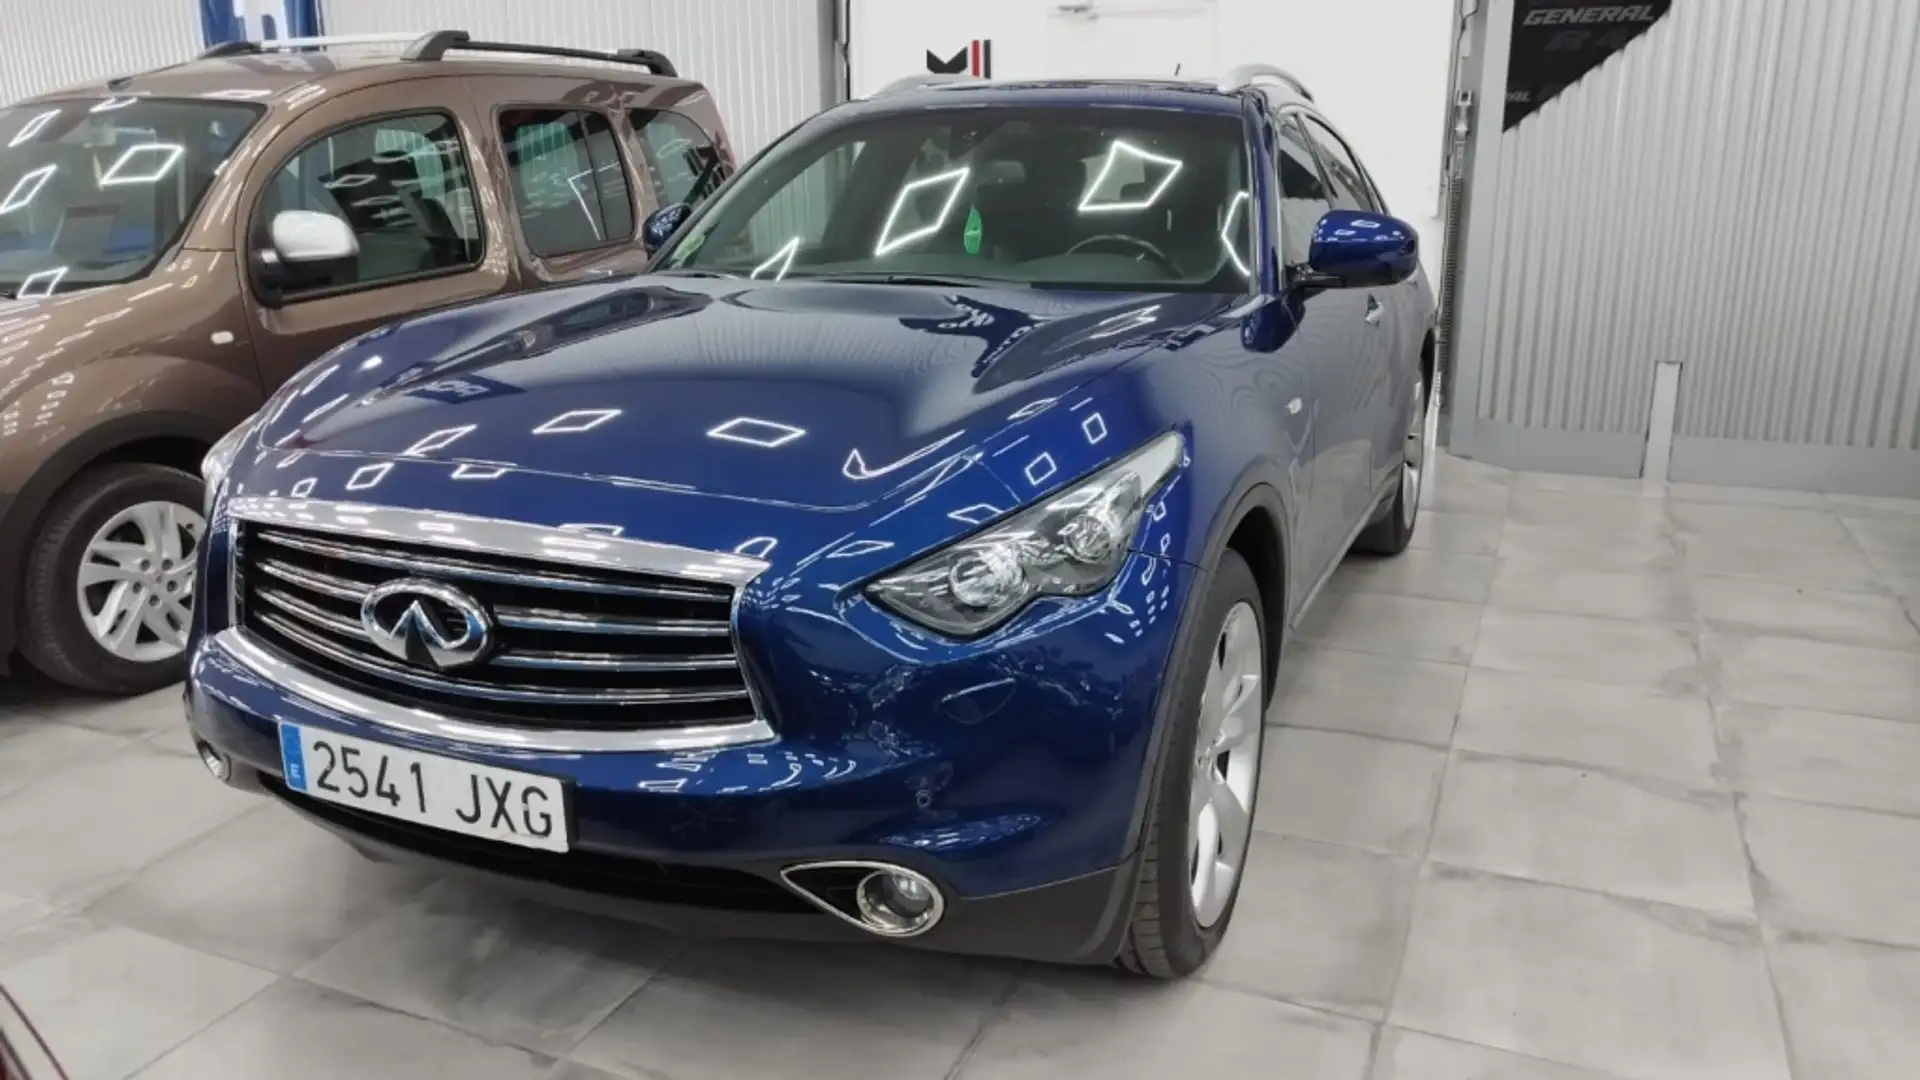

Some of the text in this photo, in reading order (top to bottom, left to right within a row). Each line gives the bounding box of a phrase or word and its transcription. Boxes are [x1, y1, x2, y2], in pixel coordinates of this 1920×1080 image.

[1523, 5, 1654, 26] GENERAL
[312, 740, 552, 838] 2541 JXG
